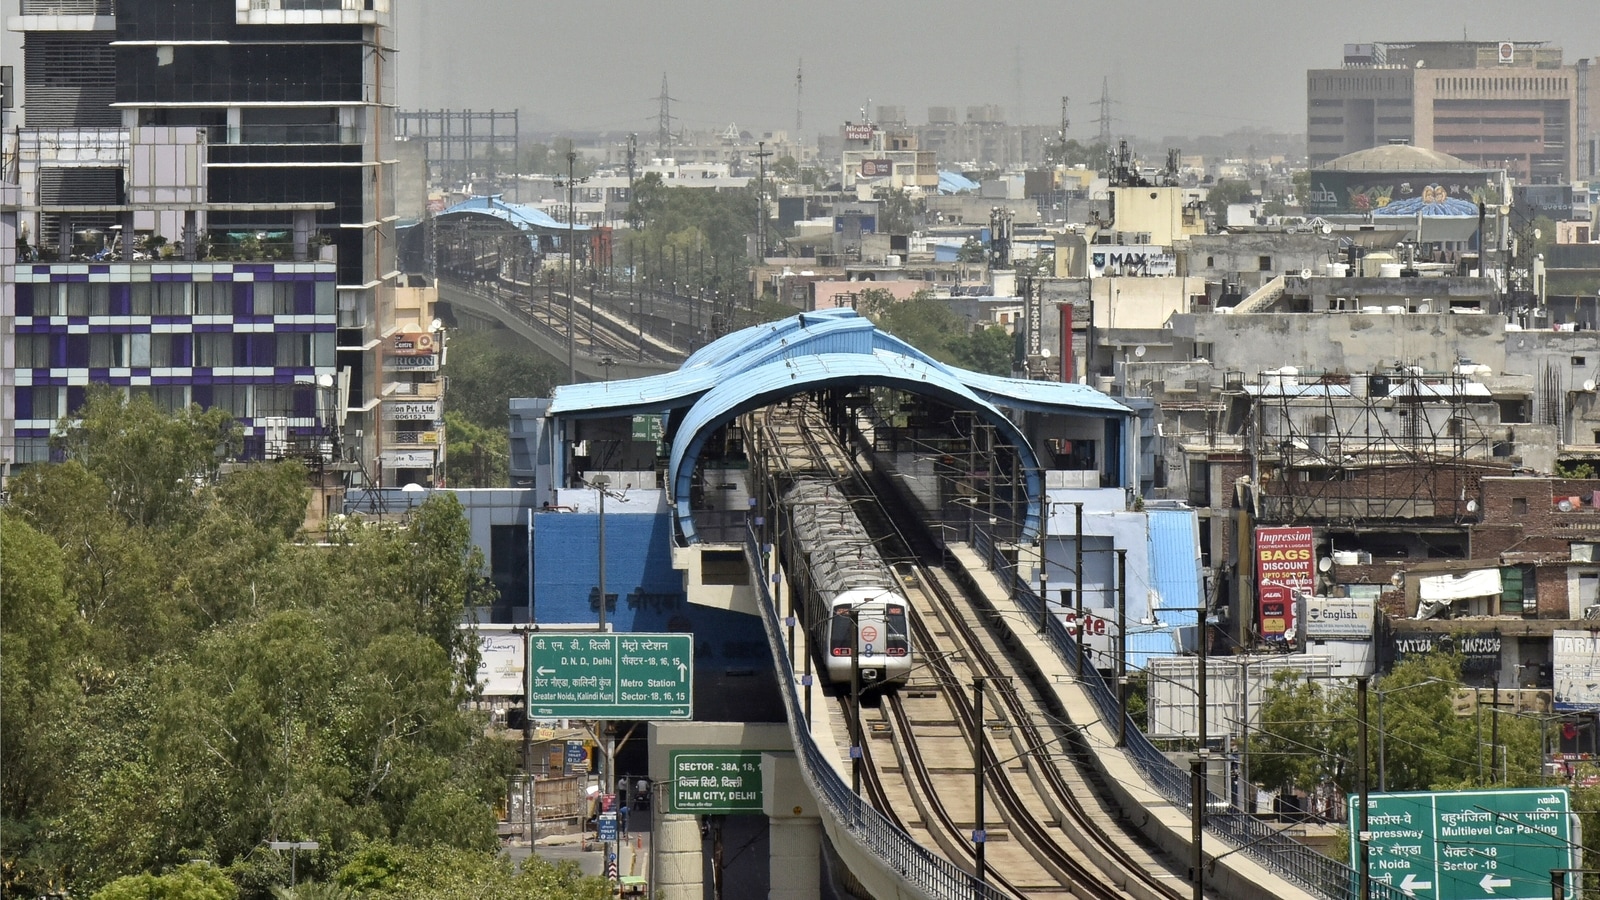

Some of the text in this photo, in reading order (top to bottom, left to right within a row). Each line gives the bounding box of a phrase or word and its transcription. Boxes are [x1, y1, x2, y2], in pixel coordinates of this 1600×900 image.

[1110, 252, 1147, 267] MAX
[406, 404, 420, 413] Pvt.
[421, 404, 436, 412] Ltd.
[1260, 531, 1311, 544] Impression
[1260, 549, 1310, 561] BAGS
[1263, 561, 1309, 570] DISCOUNT
[1066, 612, 1105, 636] Ste
[589, 638, 611, 651] दिल्ली
[1396, 639, 1432, 653] TATTOO
[592, 657, 613, 666] Delhi
[660, 657, 670, 667] 16,
[672, 657, 681, 666] 15
[620, 679, 676, 687] Metro Station
[532, 692, 556, 701] Greater
[577, 692, 599, 701] Kalindi
[599, 692, 614, 703] Kunj
[663, 692, 674, 702] 16,
[676, 692, 685, 700] 15
[678, 763, 714, 771] SECTOR
[721, 763, 740, 773] 38A,
[742, 763, 755, 773] 18,
[721, 776, 743, 788] दिल्ली
[678, 791, 756, 801] FILM CITY, DELHI
[1370, 829, 1424, 841] pressway
[1441, 823, 1558, 836] Multilevel Car Parking
[1379, 859, 1411, 870] Noida
[1443, 860, 1498, 871] Sector -18
